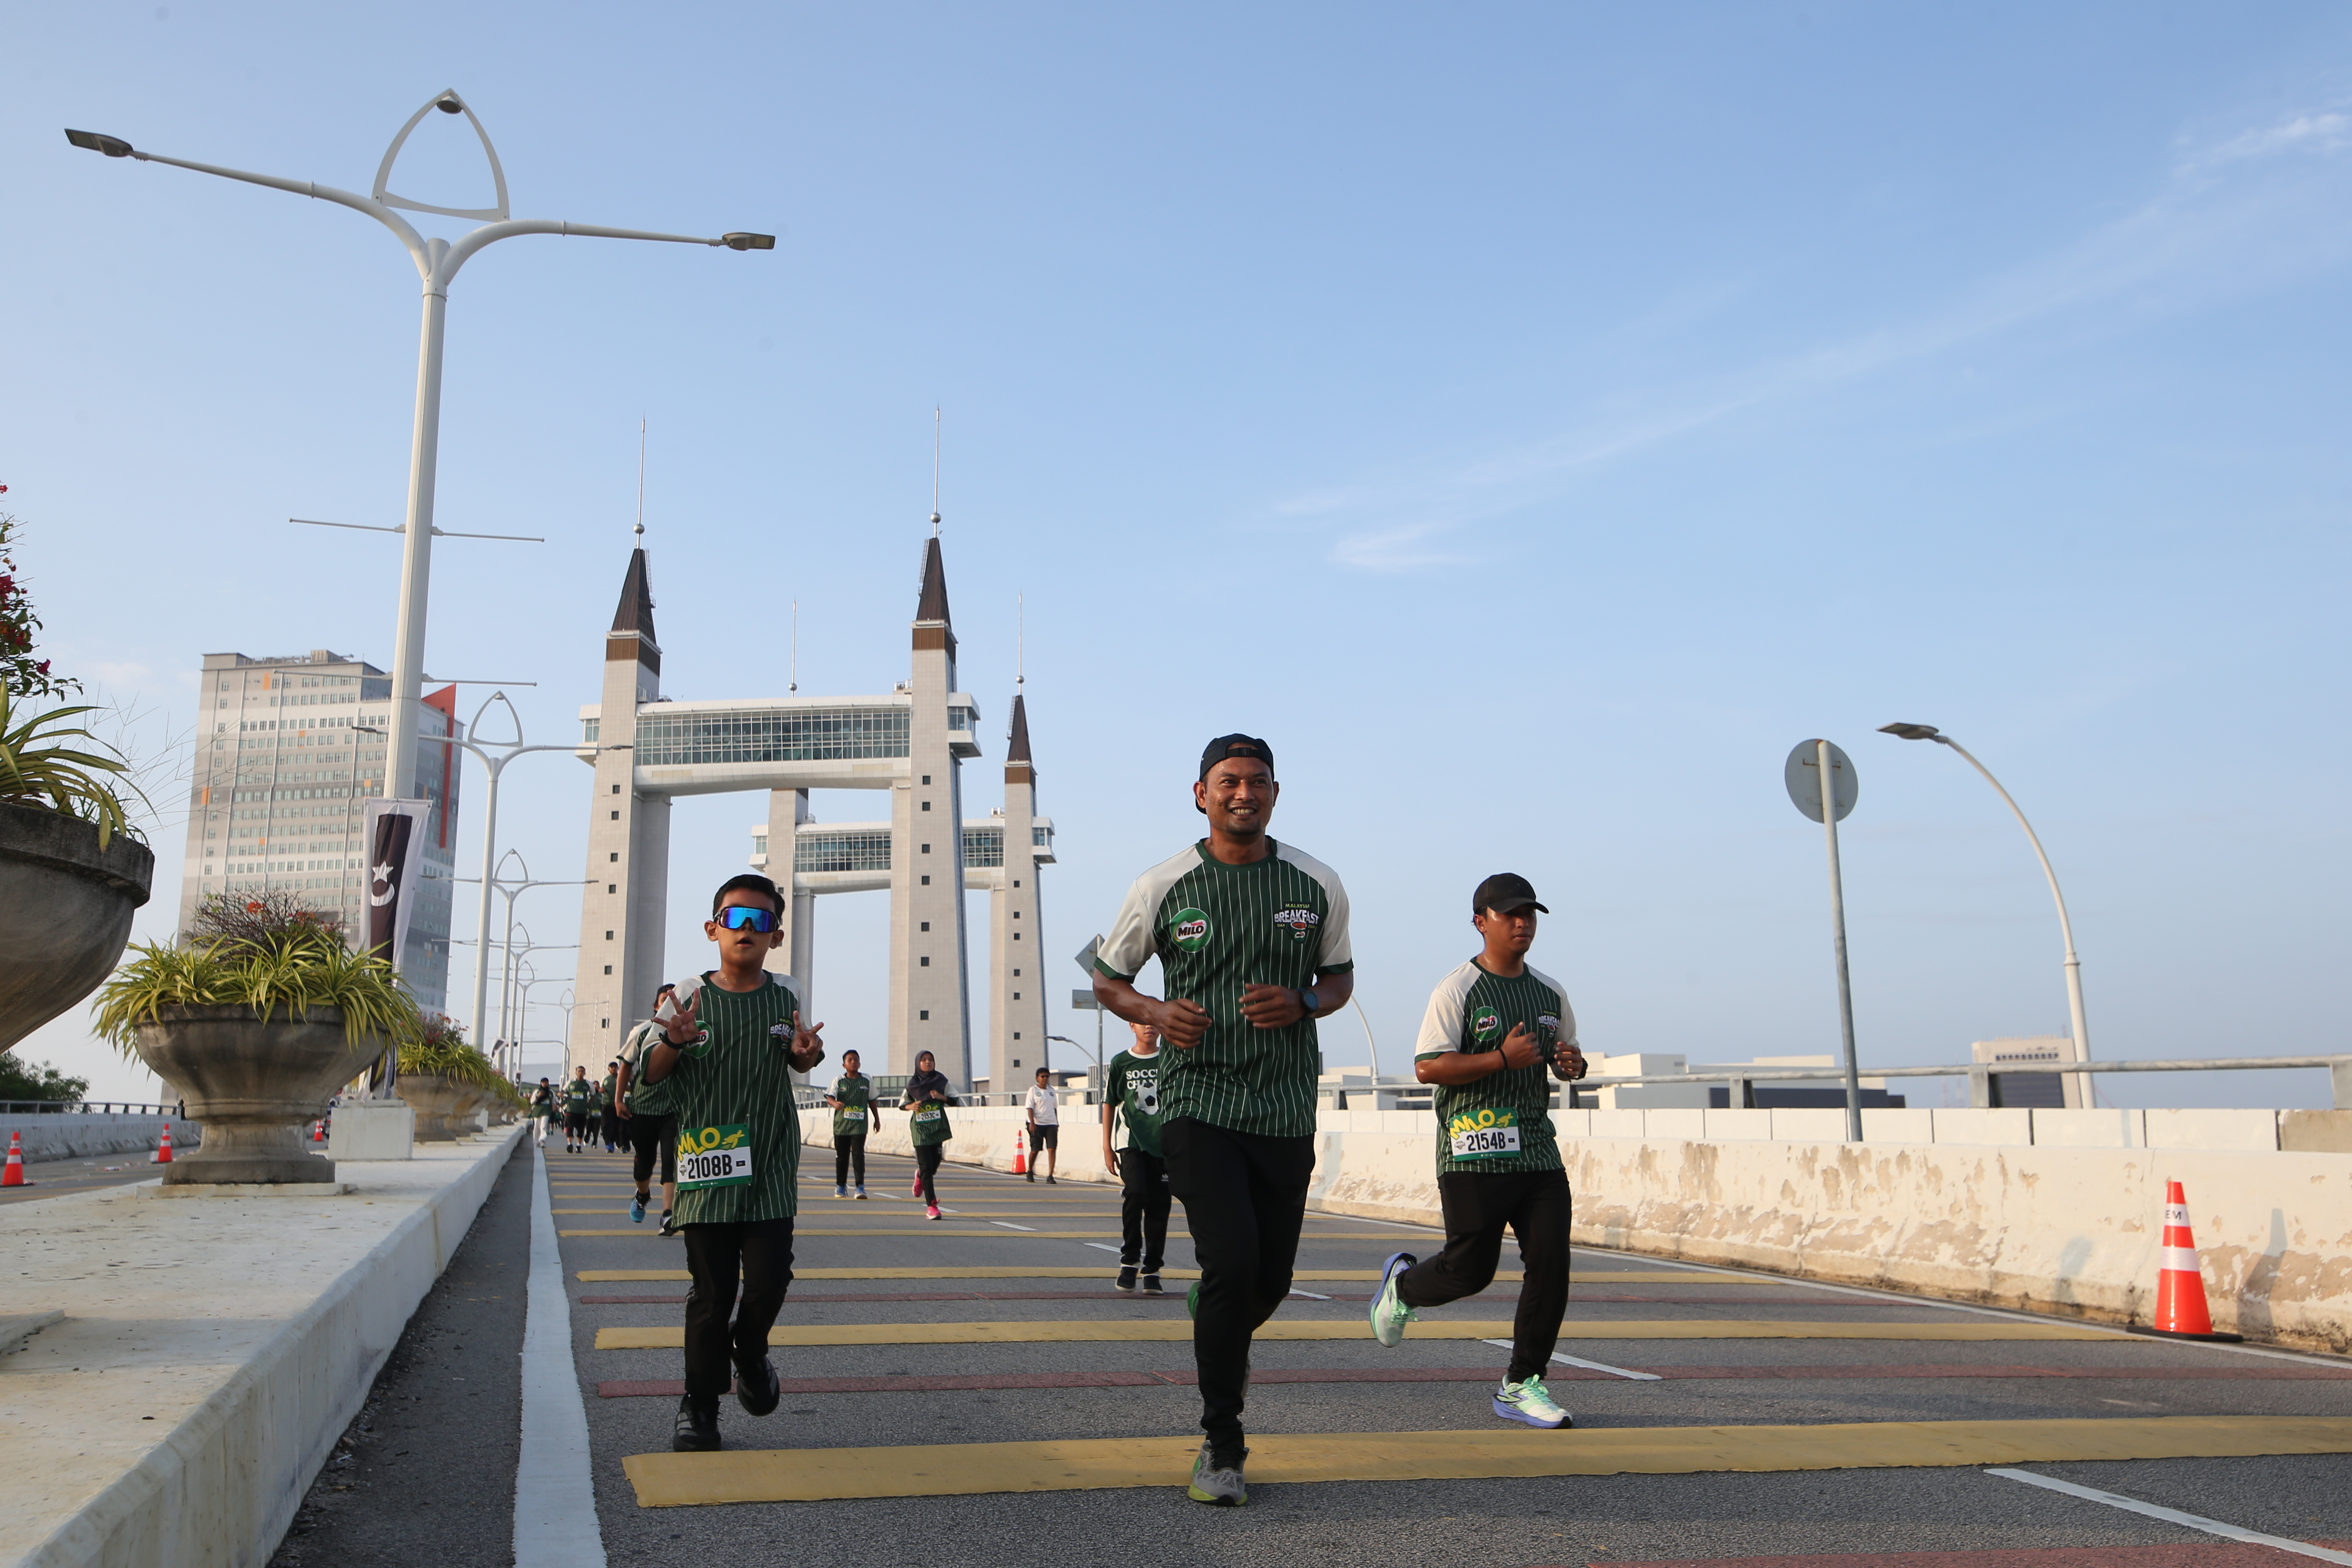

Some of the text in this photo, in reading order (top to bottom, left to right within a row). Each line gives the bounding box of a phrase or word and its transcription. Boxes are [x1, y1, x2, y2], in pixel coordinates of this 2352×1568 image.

[1274, 909, 1319, 924] BREAKFAST
[1178, 925, 1204, 937] MILO
[1478, 1019, 1495, 1029] MILO
[1539, 1015, 1559, 1028] BREAKFA
[1450, 1109, 1495, 1140] MILO
[677, 1127, 720, 1163] MILO
[1466, 1132, 1506, 1152] 2154B
[688, 1154, 733, 1179] 2108B
